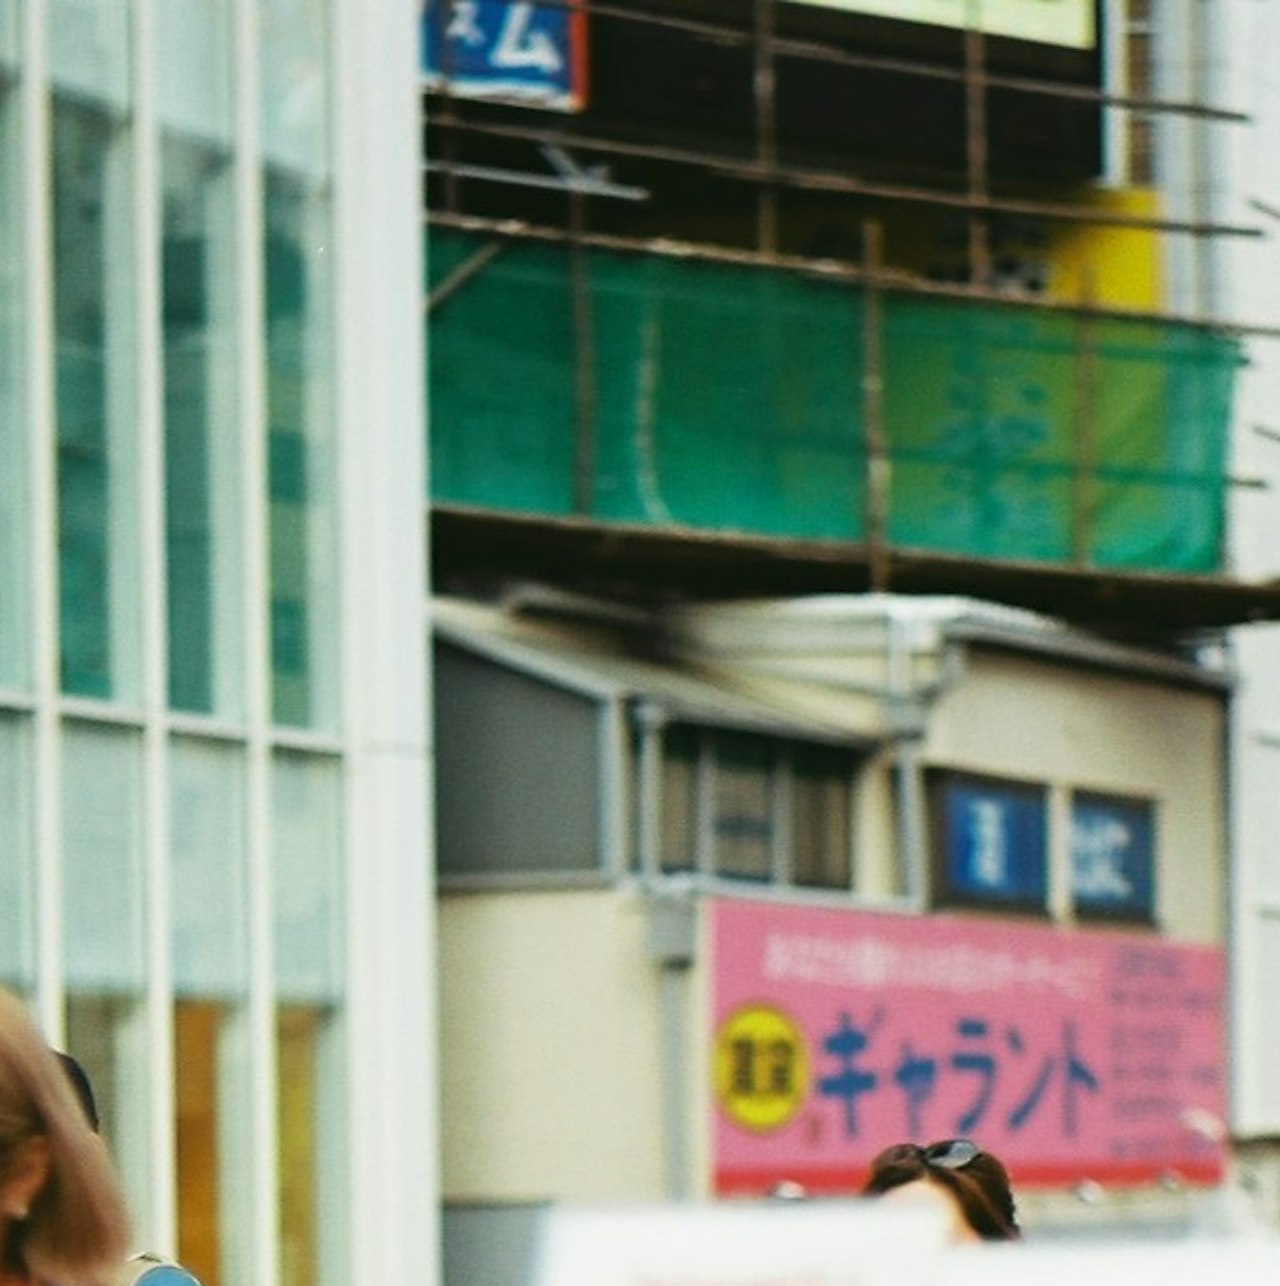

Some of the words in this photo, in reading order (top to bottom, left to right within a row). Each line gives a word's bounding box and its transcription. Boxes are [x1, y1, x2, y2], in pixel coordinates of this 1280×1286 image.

[814, 1006, 1100, 1139] ギャラント
